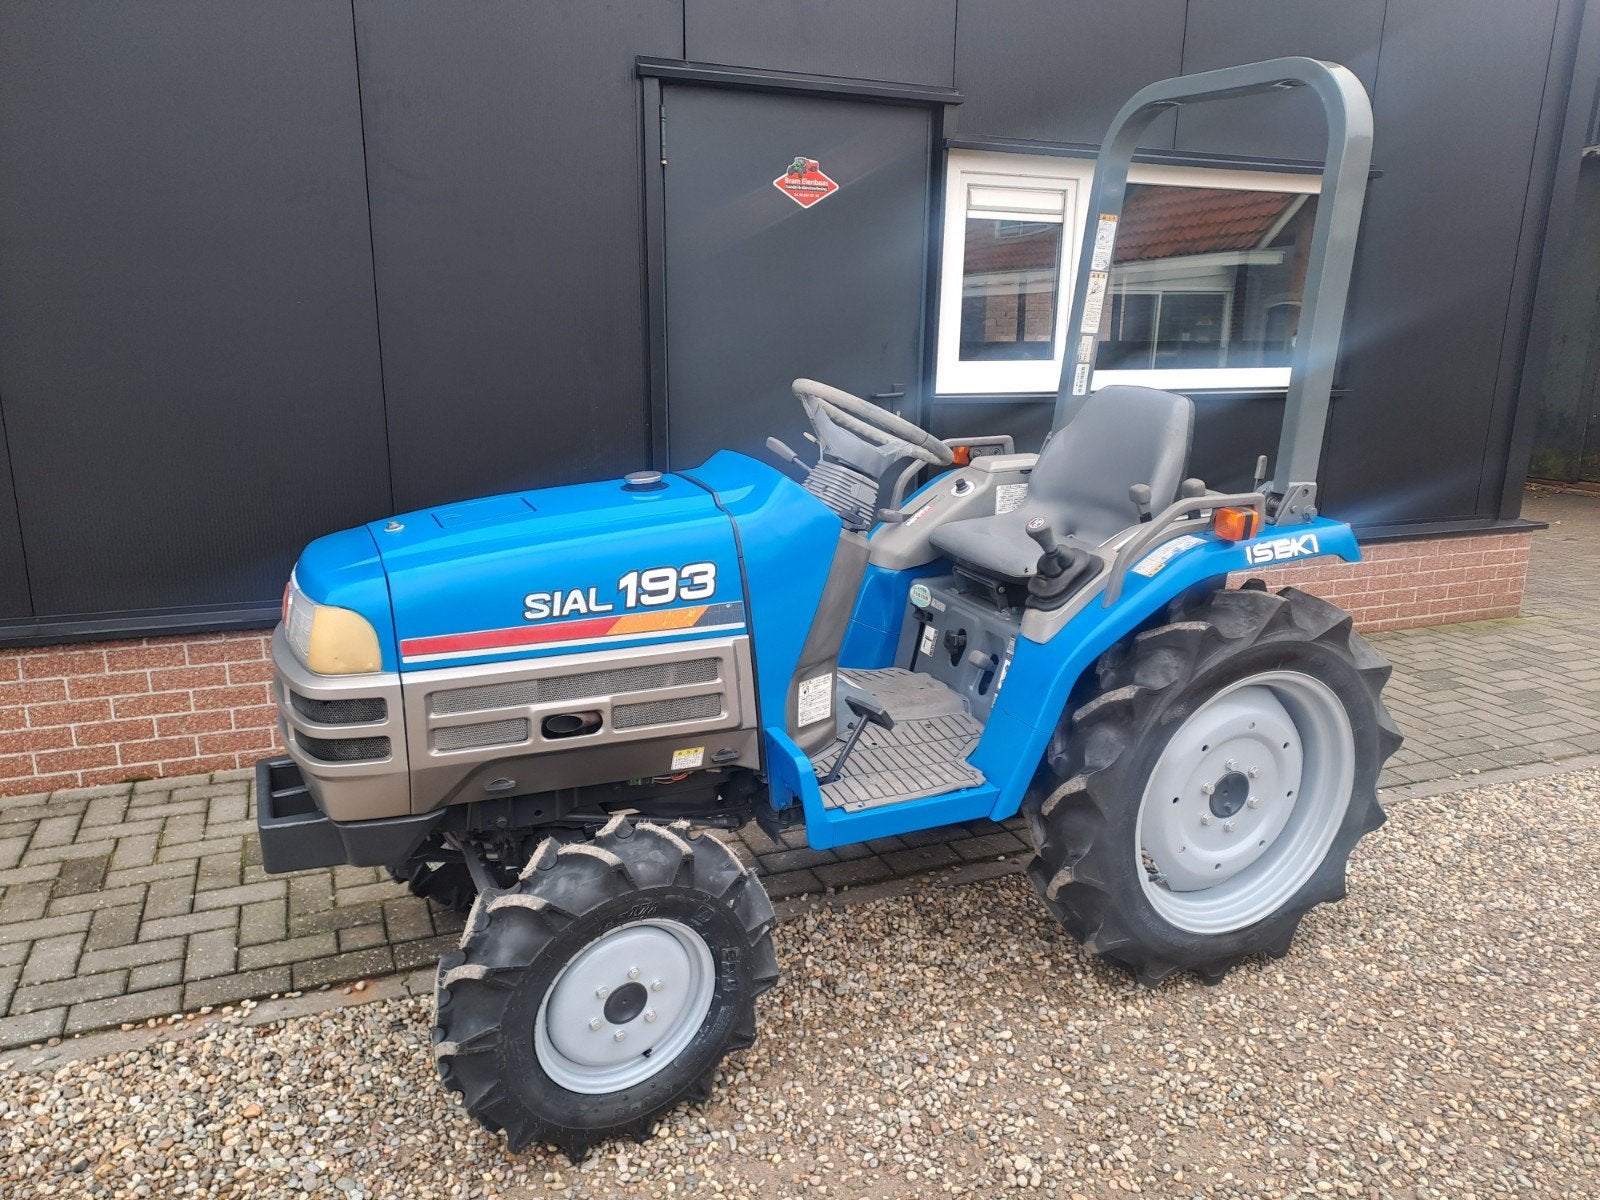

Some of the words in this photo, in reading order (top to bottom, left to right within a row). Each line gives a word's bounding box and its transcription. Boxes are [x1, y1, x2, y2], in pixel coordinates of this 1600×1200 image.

[1245, 534, 1319, 564] ISEKI
[524, 587, 613, 620] SIAL
[618, 561, 717, 608] 193
